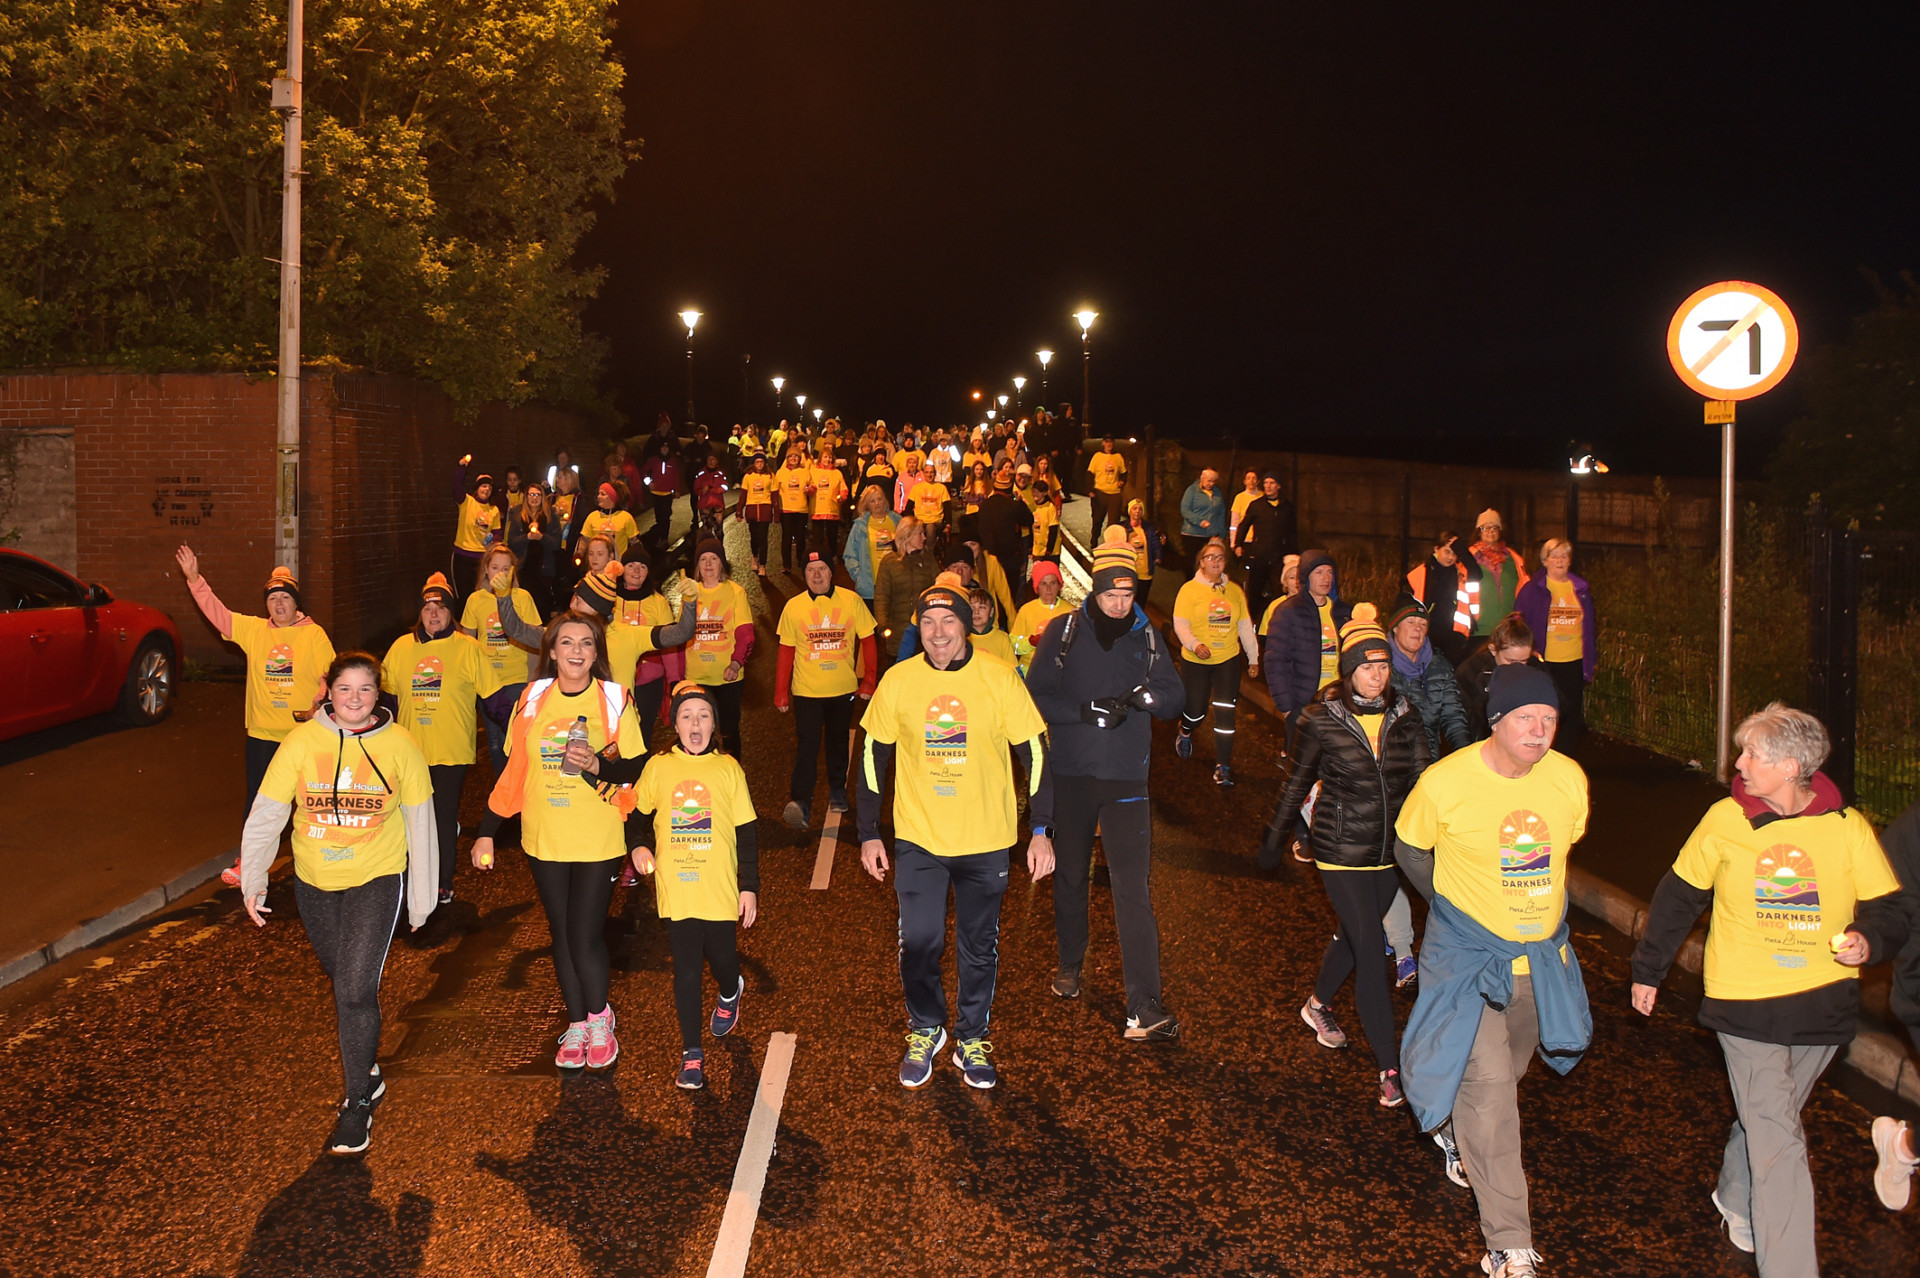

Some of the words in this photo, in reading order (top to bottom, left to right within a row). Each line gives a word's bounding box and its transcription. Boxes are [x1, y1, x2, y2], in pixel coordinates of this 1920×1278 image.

[170, 516, 201, 526] RNU
[695, 633, 720, 641] LIGHT
[809, 631, 845, 639] DARKNESS
[814, 641, 841, 650] LIGHT
[944, 757, 967, 765] LIGHT
[306, 780, 331, 790] Pieta
[353, 782, 384, 792] House
[306, 796, 383, 810] DARKNESS
[315, 813, 372, 828] LIGHT
[307, 825, 326, 840] 2017
[670, 836, 712, 844] DARKNESS
[689, 843, 712, 851] LIGHT
[1502, 877, 1552, 888] DARKNESS
[1502, 887, 1526, 897] INTO
[1528, 885, 1552, 897] LIGHT
[1756, 911, 1822, 922] DARKNESS
[1757, 920, 1785, 929] INTO
[1788, 921, 1822, 931] LIGHT
[1764, 936, 1782, 944] Pieta
